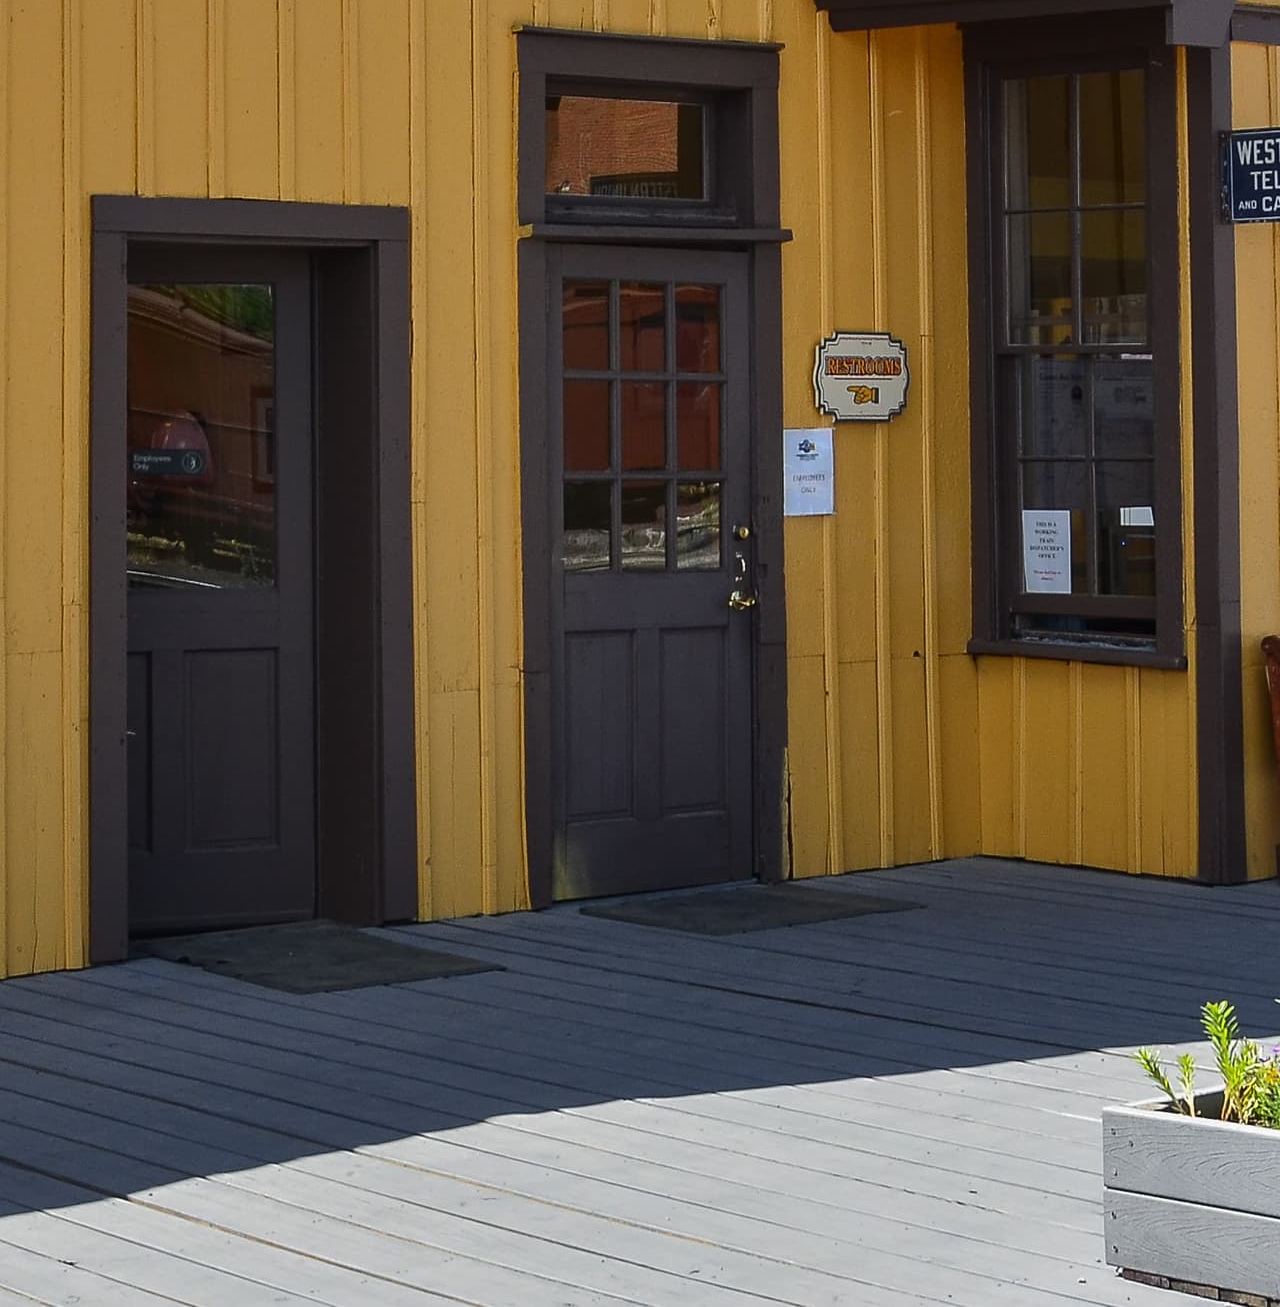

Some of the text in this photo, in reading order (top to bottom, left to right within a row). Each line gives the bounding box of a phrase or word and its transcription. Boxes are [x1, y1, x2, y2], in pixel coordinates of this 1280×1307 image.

[1238, 200, 1257, 210] AND
[825, 356, 902, 376] RESTROOMS
[133, 454, 172, 463] Employees
[133, 462, 150, 471] Only
